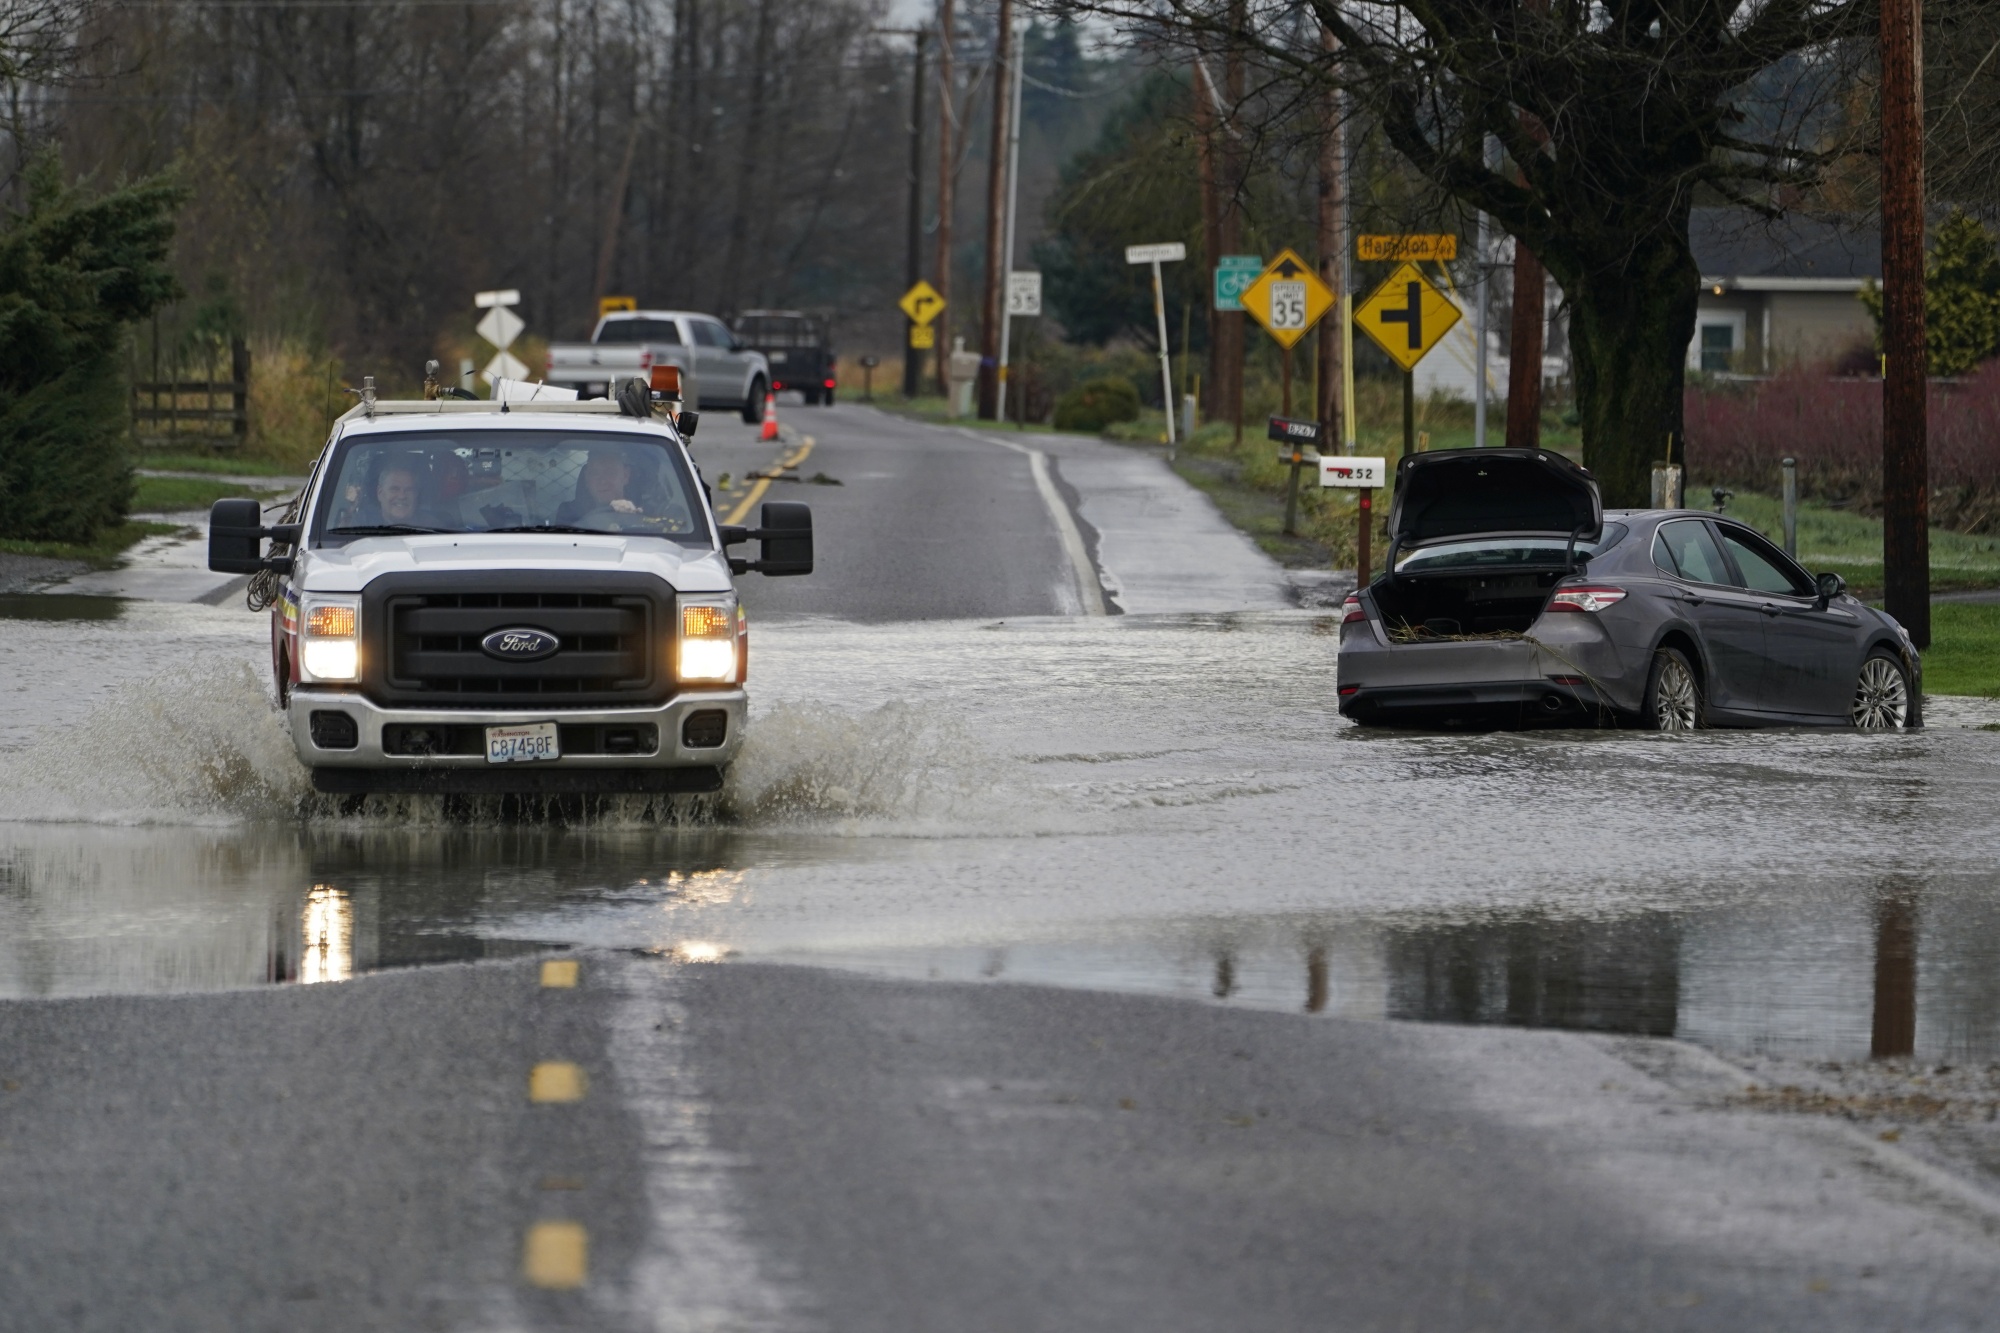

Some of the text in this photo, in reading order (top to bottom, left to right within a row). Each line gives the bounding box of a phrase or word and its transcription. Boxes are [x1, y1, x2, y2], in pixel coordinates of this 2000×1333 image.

[1274, 283, 1304, 292] SPEED
[1277, 292, 1300, 300] LIMIT
[1274, 301, 1304, 326] 35
[500, 634, 541, 652] Ford
[491, 736, 553, 757] C87458F
